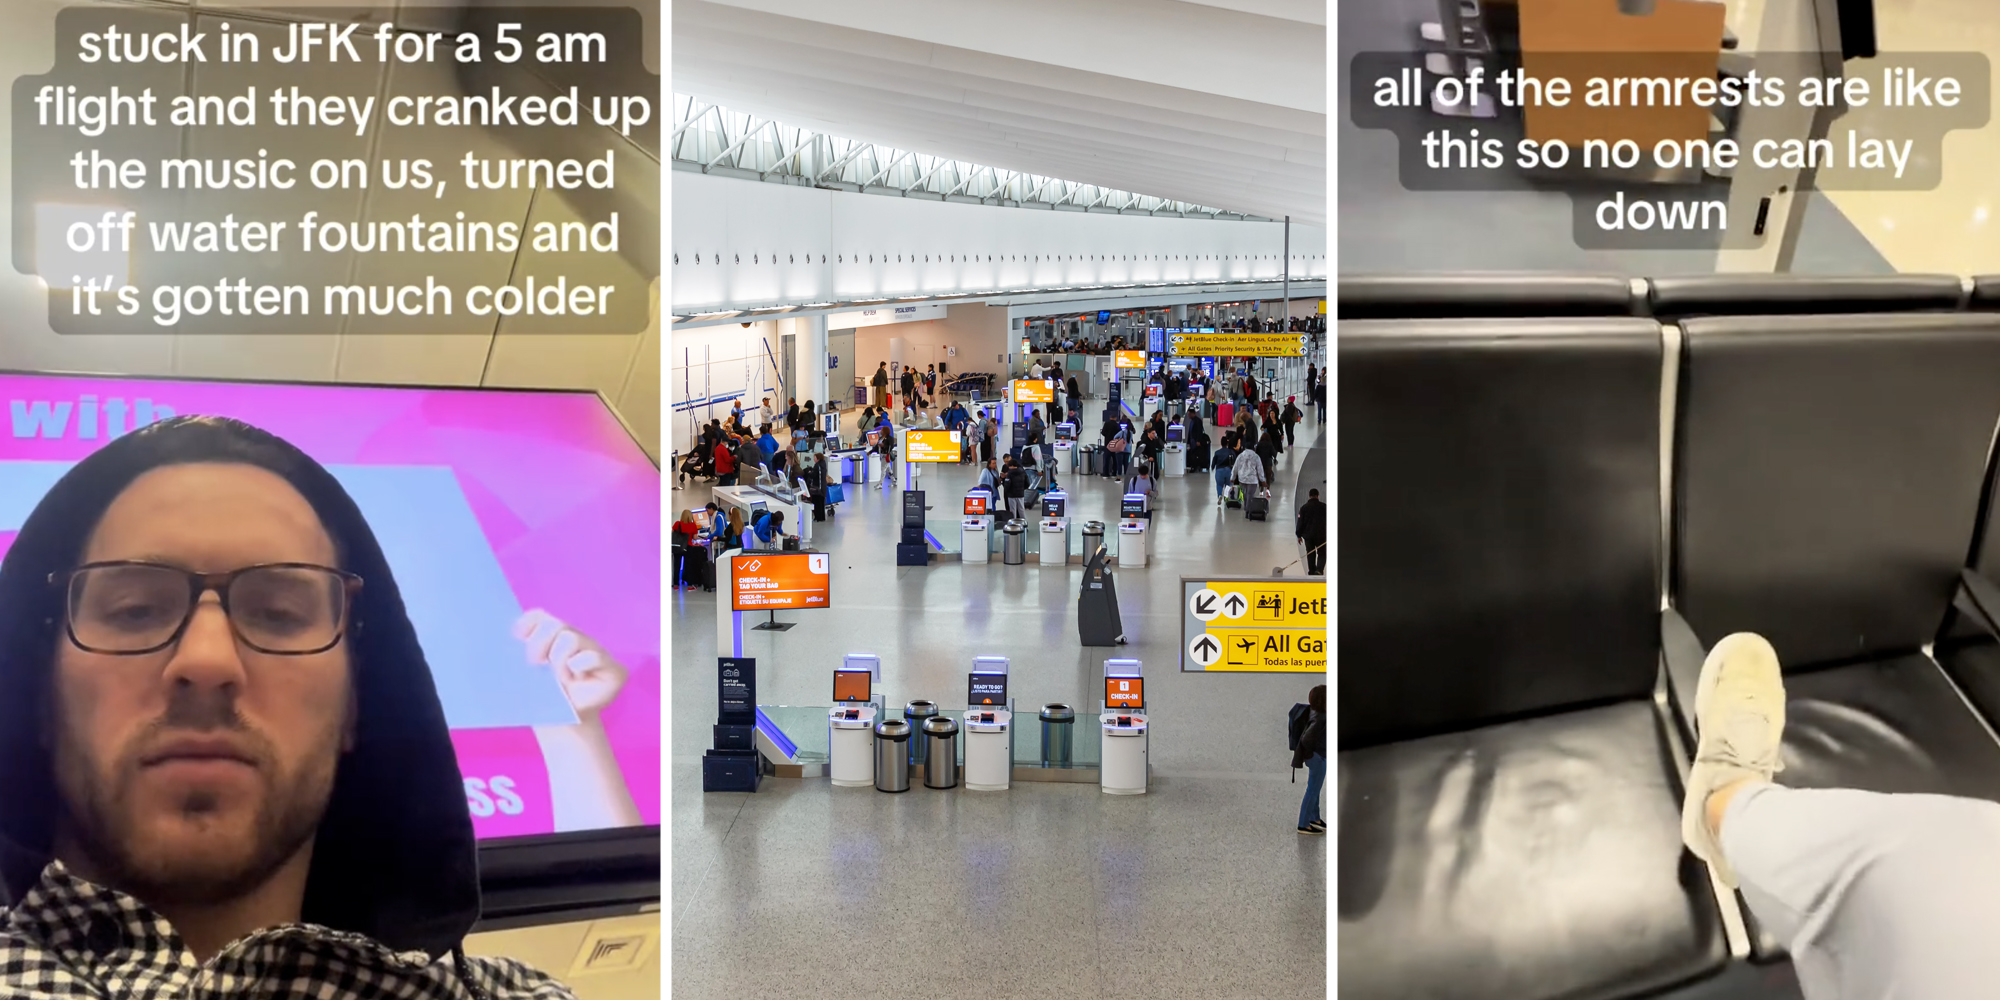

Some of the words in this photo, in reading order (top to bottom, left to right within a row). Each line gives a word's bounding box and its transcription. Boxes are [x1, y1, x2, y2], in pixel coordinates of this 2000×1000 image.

[816, 559, 821, 569] 1
[1264, 635, 1289, 652] All
[1297, 635, 1326, 653] Ga
